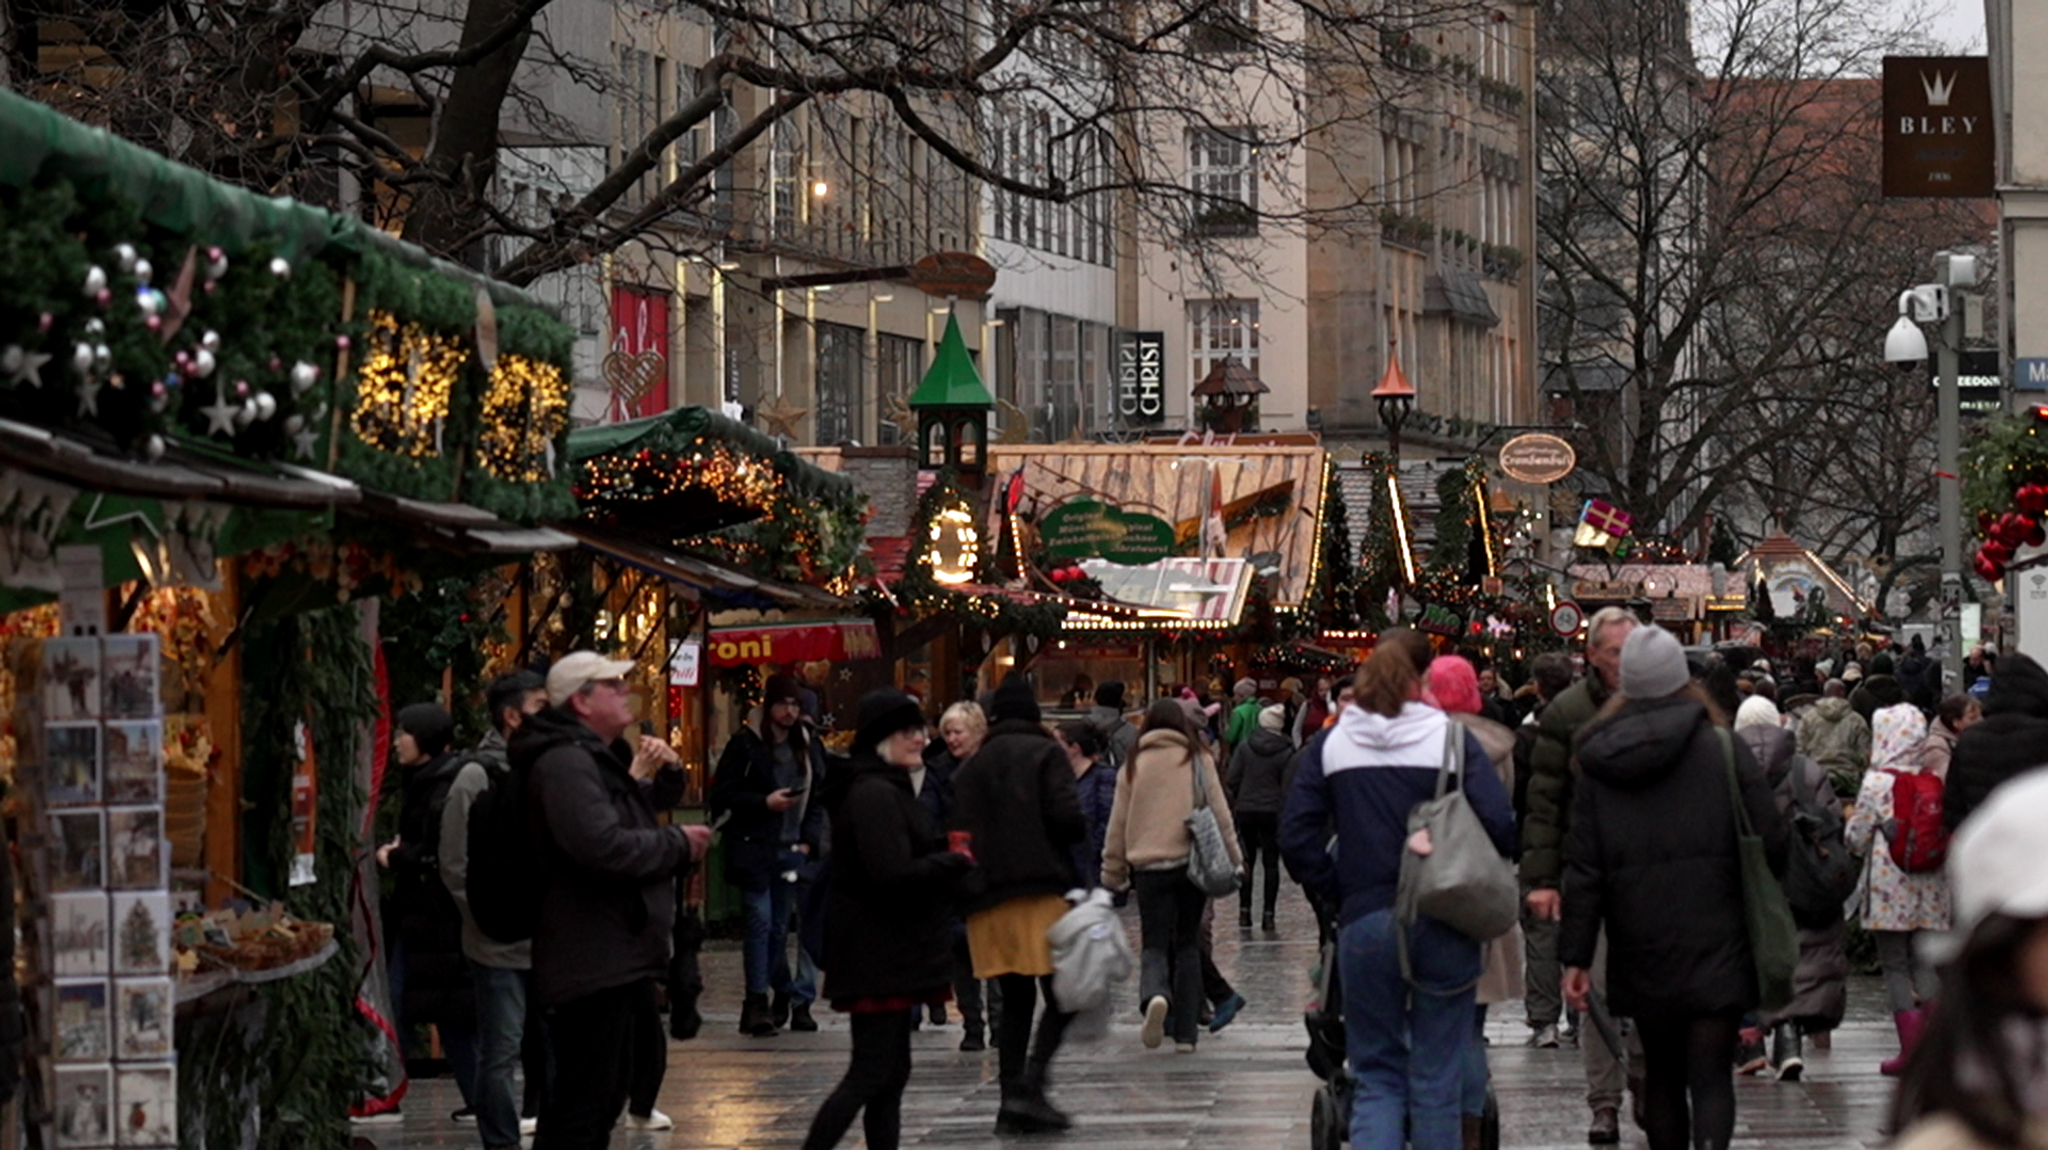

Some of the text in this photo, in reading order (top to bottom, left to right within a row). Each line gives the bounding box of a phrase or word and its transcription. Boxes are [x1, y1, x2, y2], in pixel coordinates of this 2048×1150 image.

[1900, 116, 1978, 134] BLEY
[1140, 341, 1160, 415] CHRIST
[2028, 362, 2048, 382] M
